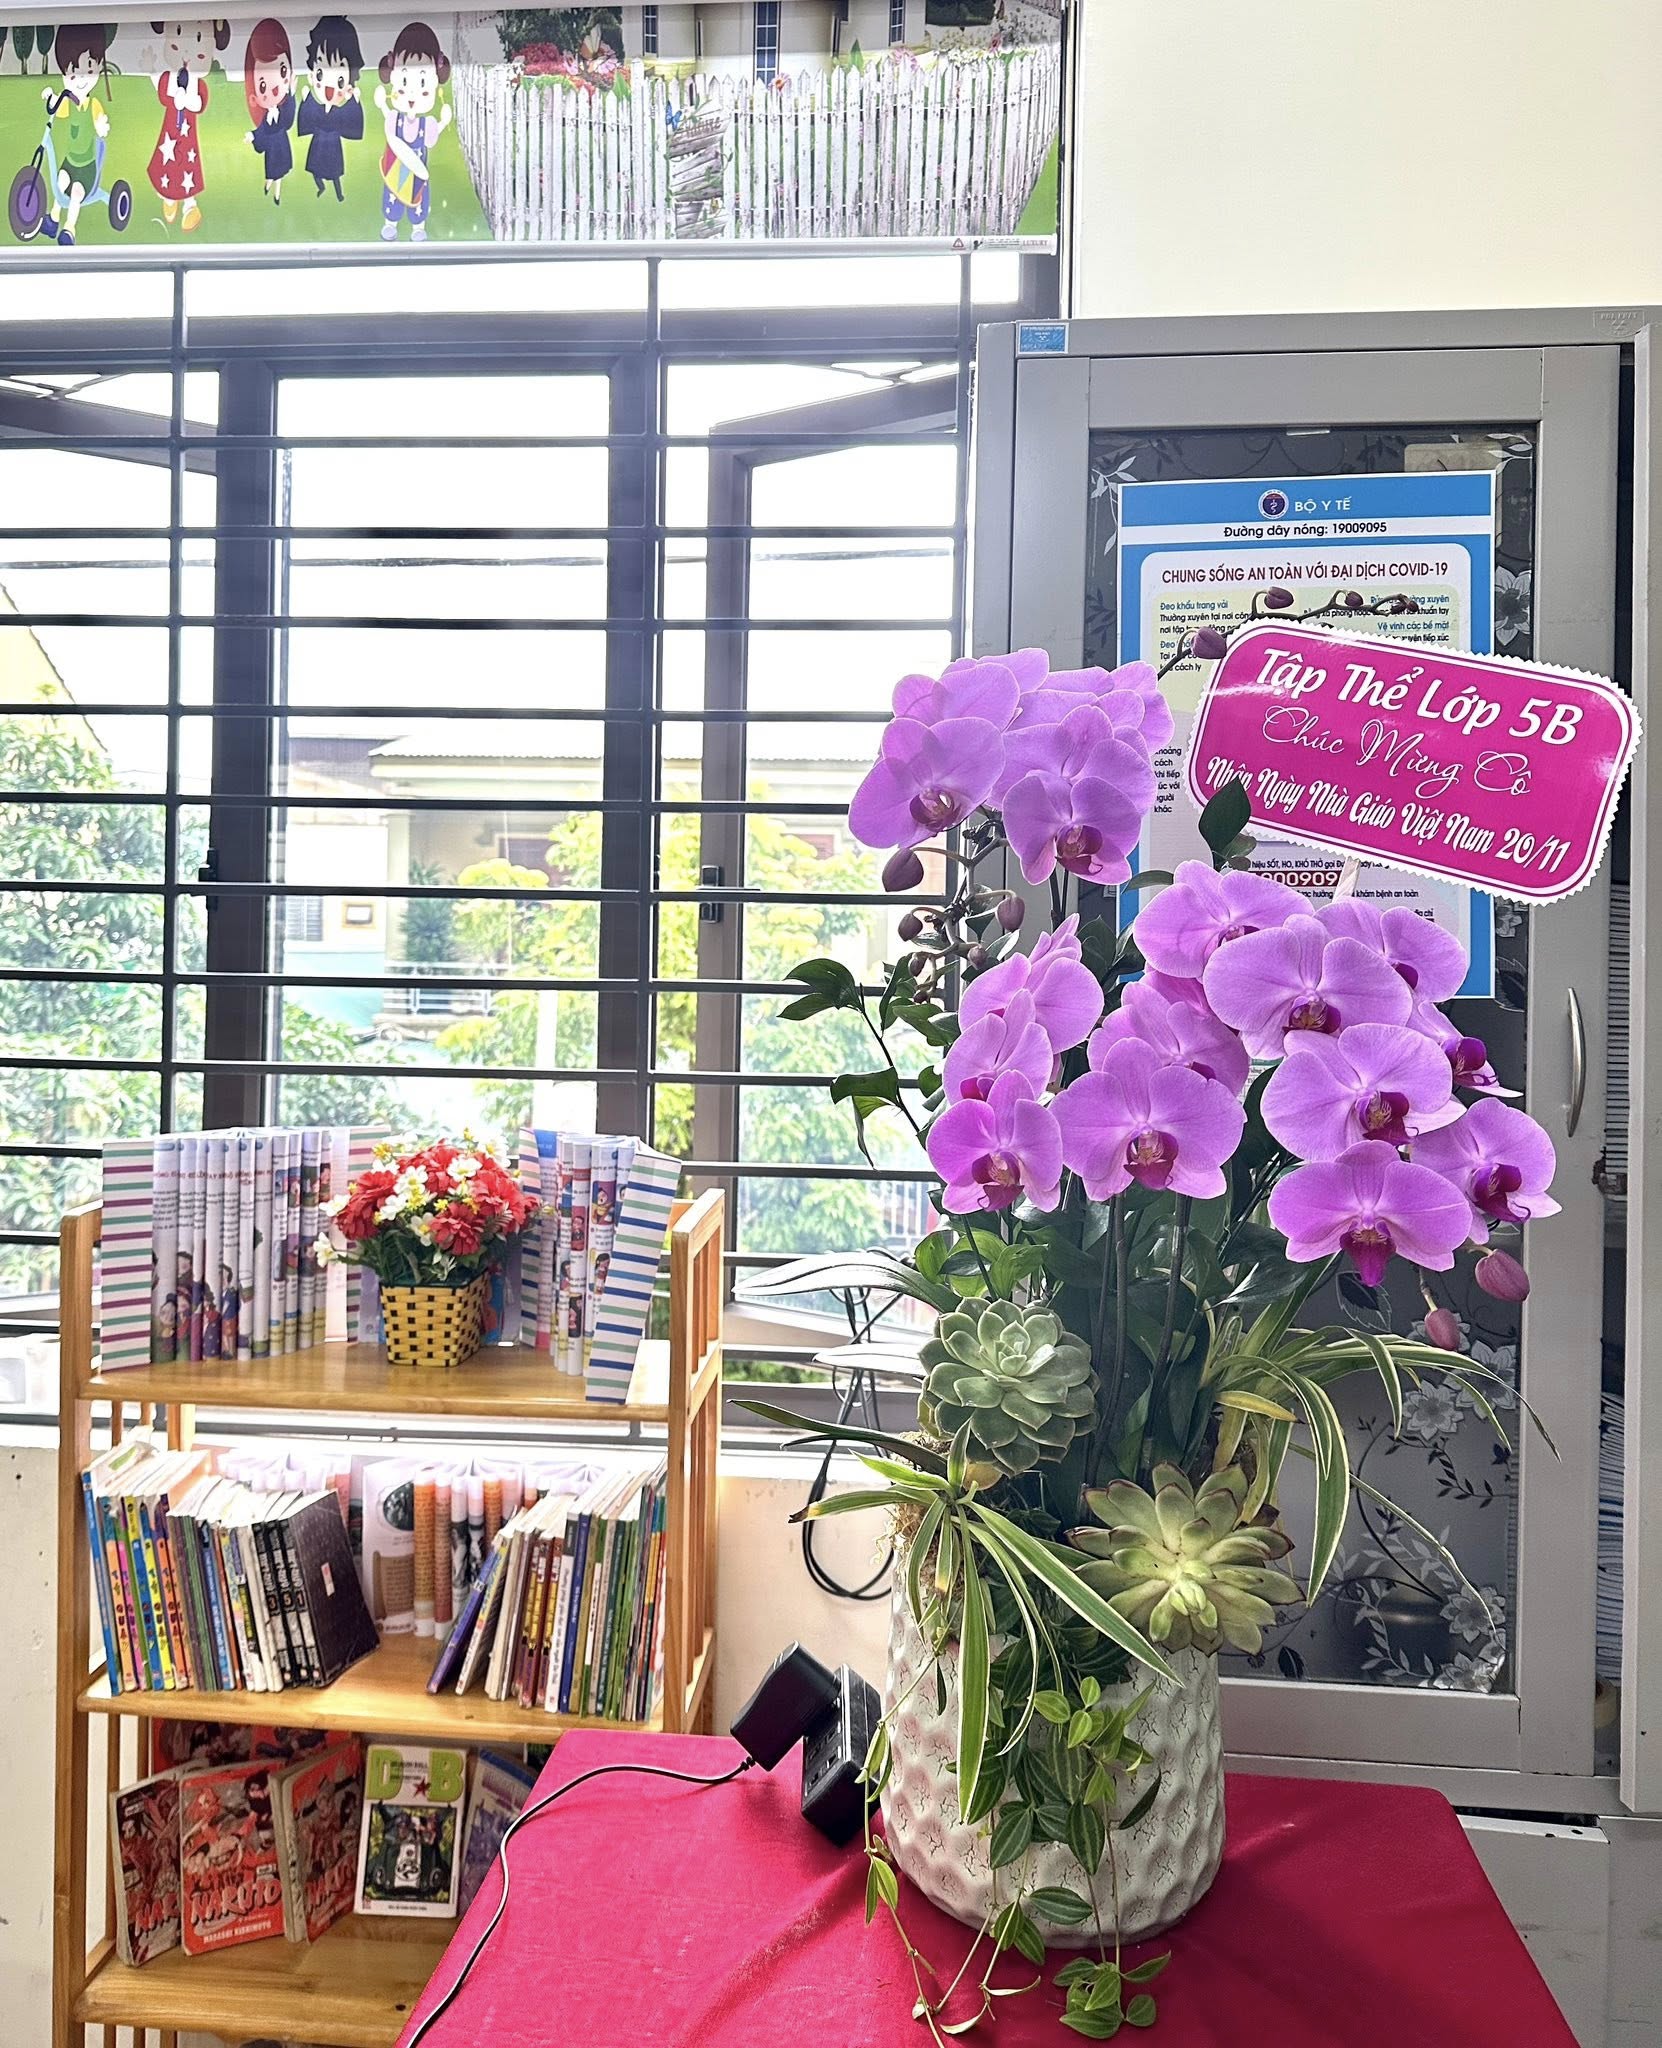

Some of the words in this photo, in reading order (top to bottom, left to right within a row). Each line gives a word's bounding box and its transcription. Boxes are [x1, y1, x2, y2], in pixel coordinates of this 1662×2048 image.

[1294, 496, 1317, 513] BỘ
[1322, 499, 1331, 512] Y
[1333, 495, 1351, 511] TẾ
[1223, 525, 1264, 540] Đường
[1267, 522, 1291, 539] dây
[1294, 522, 1328, 538] nóng:
[1332, 521, 1387, 535] 19009095
[1162, 568, 1206, 584] CHUNG
[1208, 563, 1245, 583] SỐNG
[1248, 566, 1266, 581] AN
[1268, 561, 1303, 580] TOÀN
[1305, 561, 1328, 580] VỚI
[1331, 562, 1353, 582] ĐẠI
[1356, 560, 1386, 581] DỊCH
[1388, 561, 1449, 578] COVID-19
[1427, 594, 1449, 605] xuyên
[1160, 602, 1175, 610] Đeo
[1196, 601, 1216, 611] trang
[1160, 640, 1175, 649] Đeo
[1174, 662, 1194, 672] cách
[1195, 663, 1202, 672] ly
[1255, 647, 1327, 700] Tập
[1336, 662, 1424, 713] Thể
[1416, 677, 1501, 730] Lớp
[1509, 697, 1585, 746] 5B
[1262, 704, 1345, 755] Chúc
[1356, 717, 1464, 800] Mừng
[1472, 748, 1533, 797] Cô
[1154, 758, 1173, 767] cách
[1166, 768, 1180, 779] tiếp
[1158, 781, 1168, 790] úc
[1169, 781, 1181, 790] với
[1154, 804, 1173, 813] khác
[1207, 754, 1253, 792] Nhân
[1256, 767, 1307, 815] Ngày
[1308, 778, 1350, 816] Nhà
[1350, 789, 1396, 830] Giáo
[1400, 801, 1444, 846] Việt
[1445, 812, 1494, 856] Nam
[1493, 825, 1572, 874] 20/11
[1295, 857, 1309, 868] KHÓ
[1356, 889, 1375, 898] khám
[1376, 889, 1393, 899] bệnh
[1394, 890, 1403, 898] an
[1403, 888, 1419, 898] toàn
[427, 1750, 465, 1802] B
[191, 1878, 283, 1927] NARUTO
